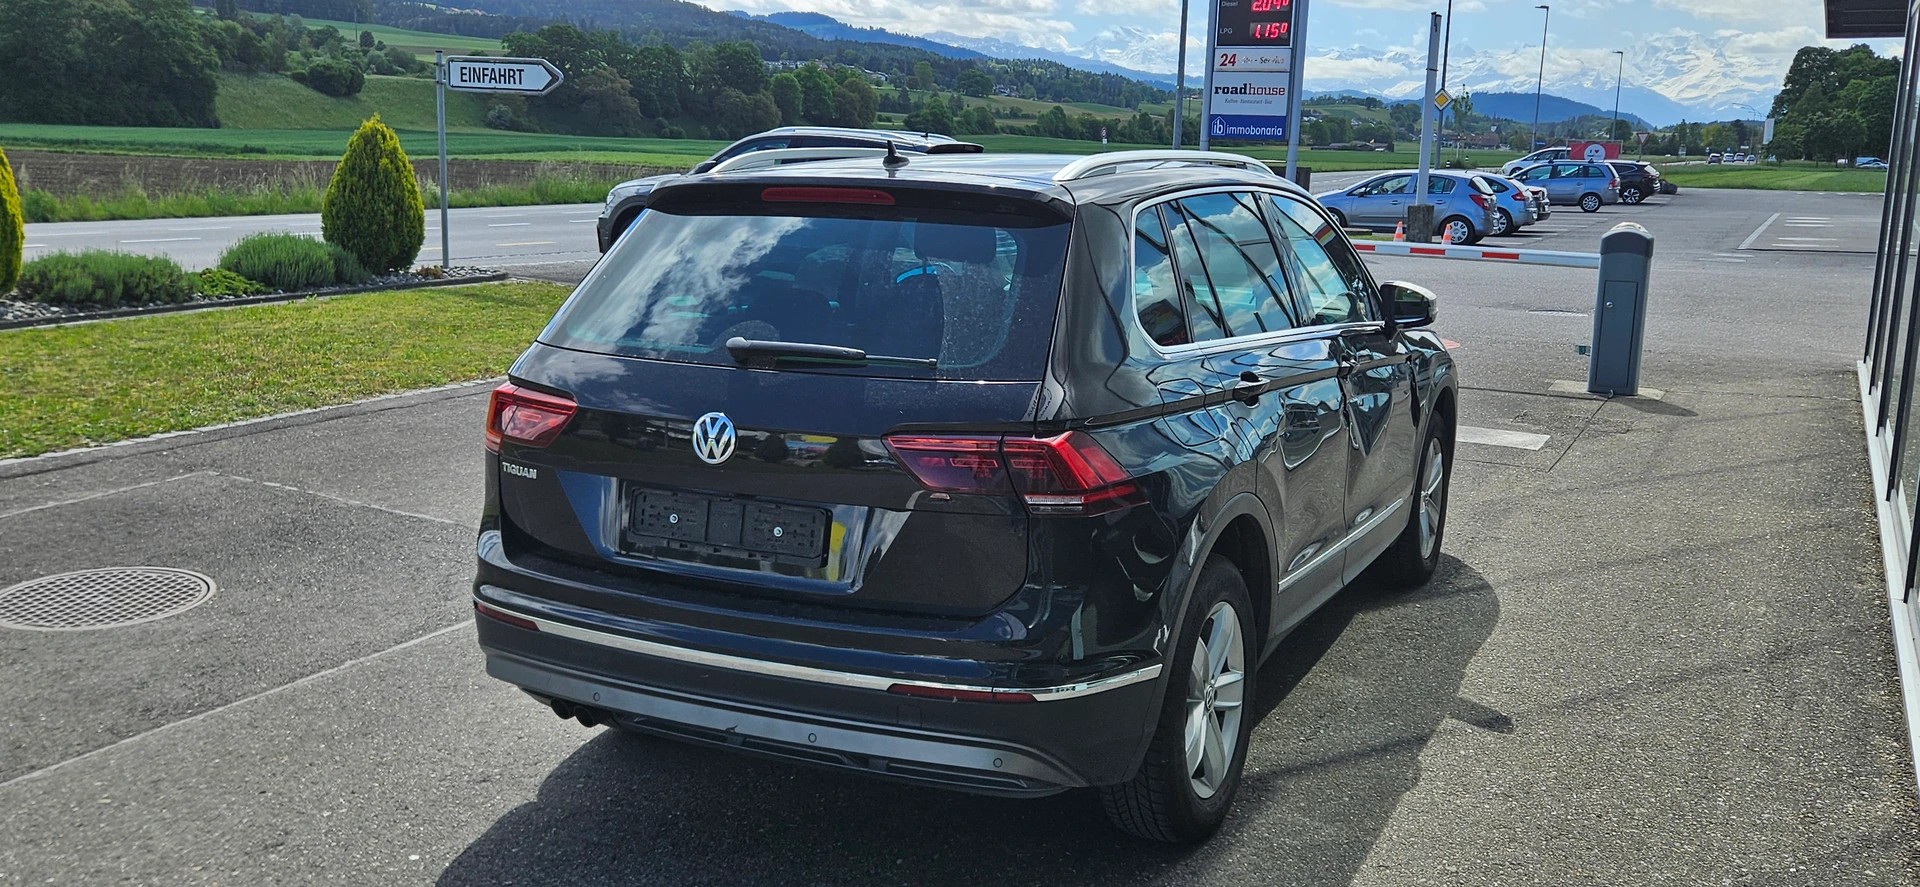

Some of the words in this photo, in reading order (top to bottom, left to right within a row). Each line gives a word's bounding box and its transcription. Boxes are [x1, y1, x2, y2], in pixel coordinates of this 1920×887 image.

[1219, 27, 1233, 35] LPG
[1219, 53, 1237, 67] 24
[460, 66, 525, 85] EINFAHRT
[1214, 83, 1286, 96] roadhouse
[1226, 124, 1283, 136] immobonaria
[692, 411, 736, 465] VW
[501, 461, 537, 479] TIGUAN
